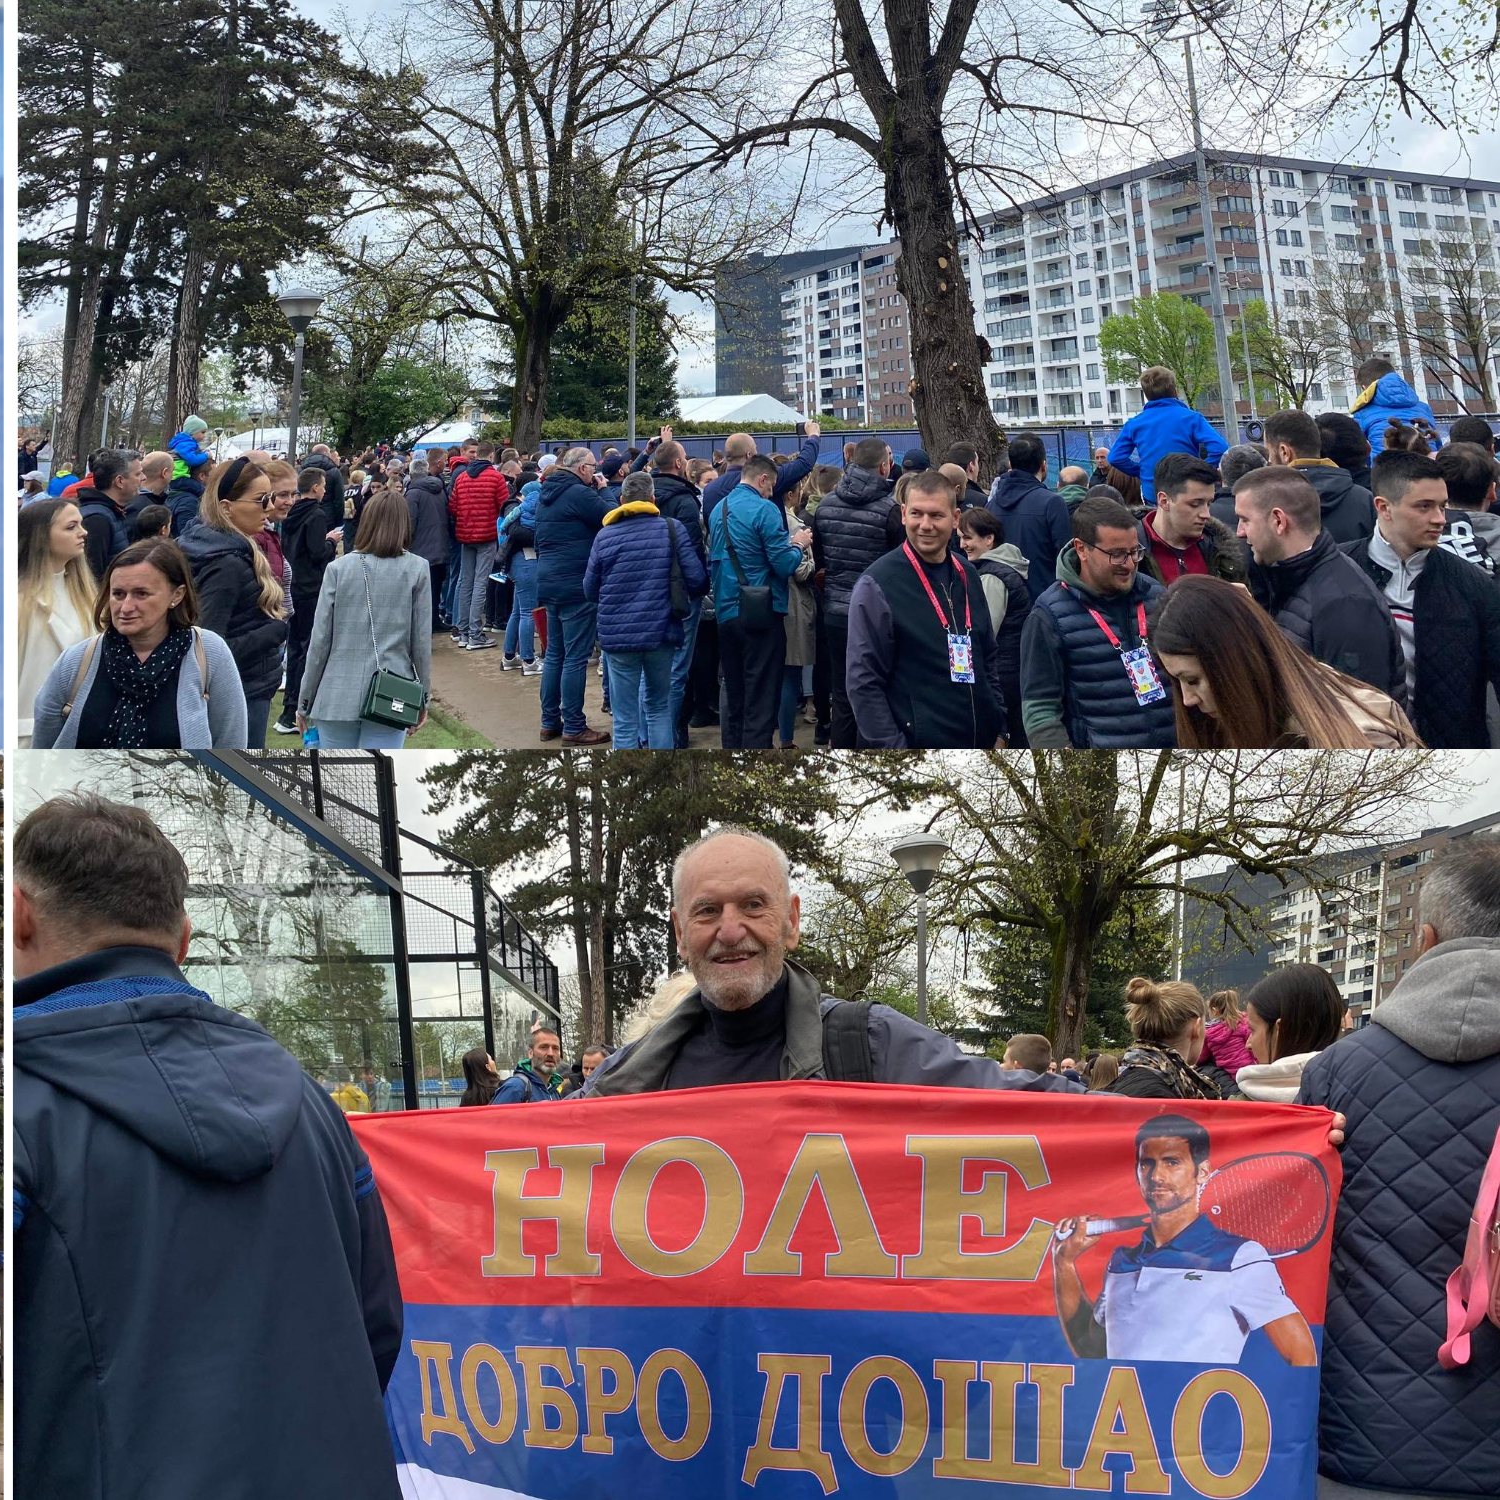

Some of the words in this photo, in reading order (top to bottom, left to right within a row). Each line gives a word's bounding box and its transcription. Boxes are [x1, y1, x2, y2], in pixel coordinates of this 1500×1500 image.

[481, 1133, 1055, 1282] НОЛЕ
[410, 1339, 712, 1462] ДОБРО
[741, 1353, 1272, 1500] ДОШАО
